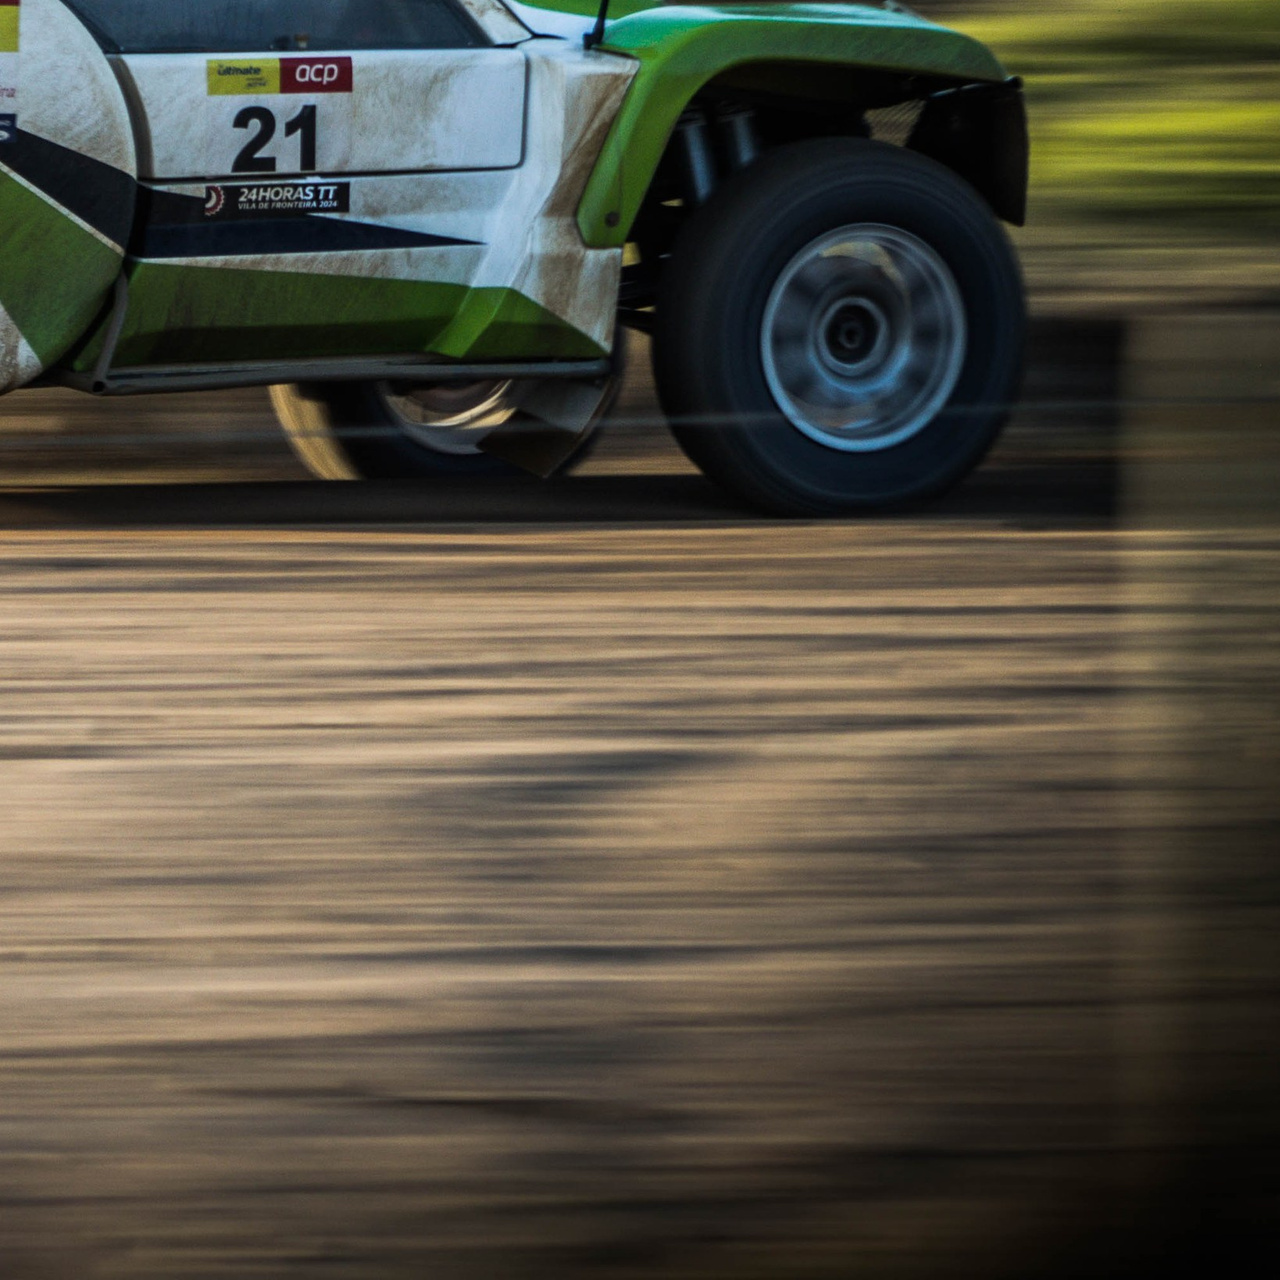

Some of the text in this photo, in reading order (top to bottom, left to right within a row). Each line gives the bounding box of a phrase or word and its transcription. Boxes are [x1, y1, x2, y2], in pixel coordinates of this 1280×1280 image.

[295, 64, 338, 85] acp
[231, 104, 316, 173] 21
[318, 185, 338, 200] TT
[238, 200, 338, 210] VILA DE FRONTEIRA 2024
